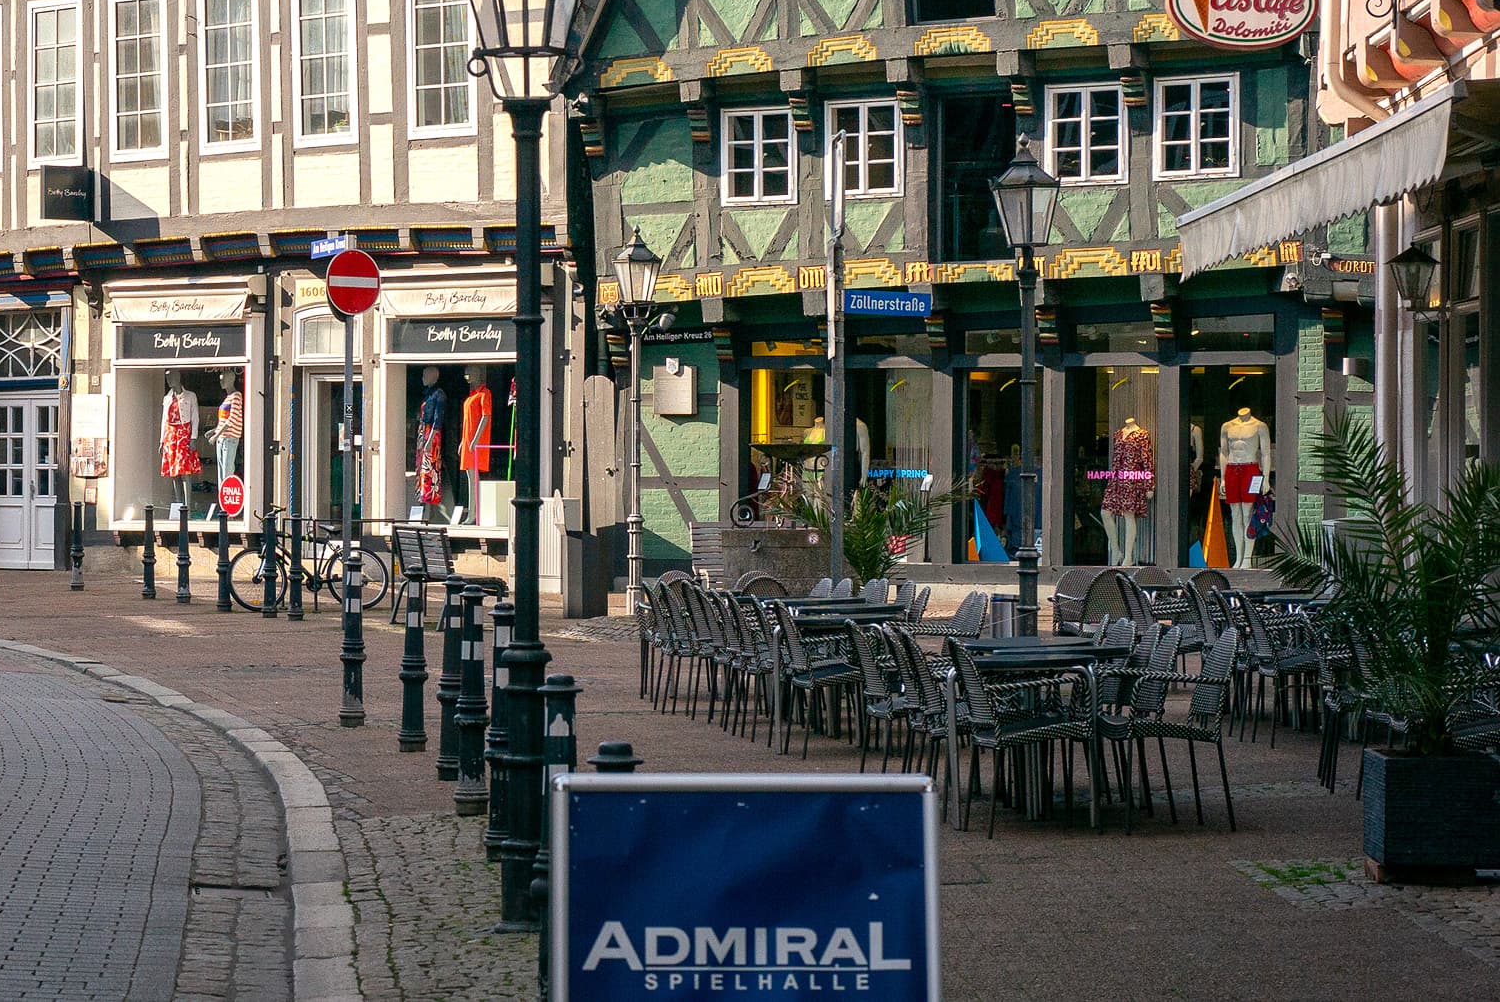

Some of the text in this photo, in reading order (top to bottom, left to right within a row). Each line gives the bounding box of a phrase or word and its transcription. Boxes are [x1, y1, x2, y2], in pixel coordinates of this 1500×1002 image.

[1211, 17, 1293, 38] Dolomiti
[299, 286, 326, 298] 1606
[424, 289, 487, 310] Betty Barclay
[149, 297, 205, 318] Betty Barclay
[849, 293, 926, 313] Zöllnerstraße
[153, 330, 221, 358] Betty Barclay
[427, 323, 502, 351] Betty Barclay
[643, 333, 655, 341] Am
[683, 331, 703, 340] Kreuz
[868, 469, 928, 479] HAPPY SPRING
[1087, 469, 1152, 480] HAPPY SPRING
[222, 486, 242, 496] FINAL
[223, 495, 240, 505] SALE
[582, 920, 912, 971] ADMIRAL
[644, 973, 870, 991] SPIELHALLE
